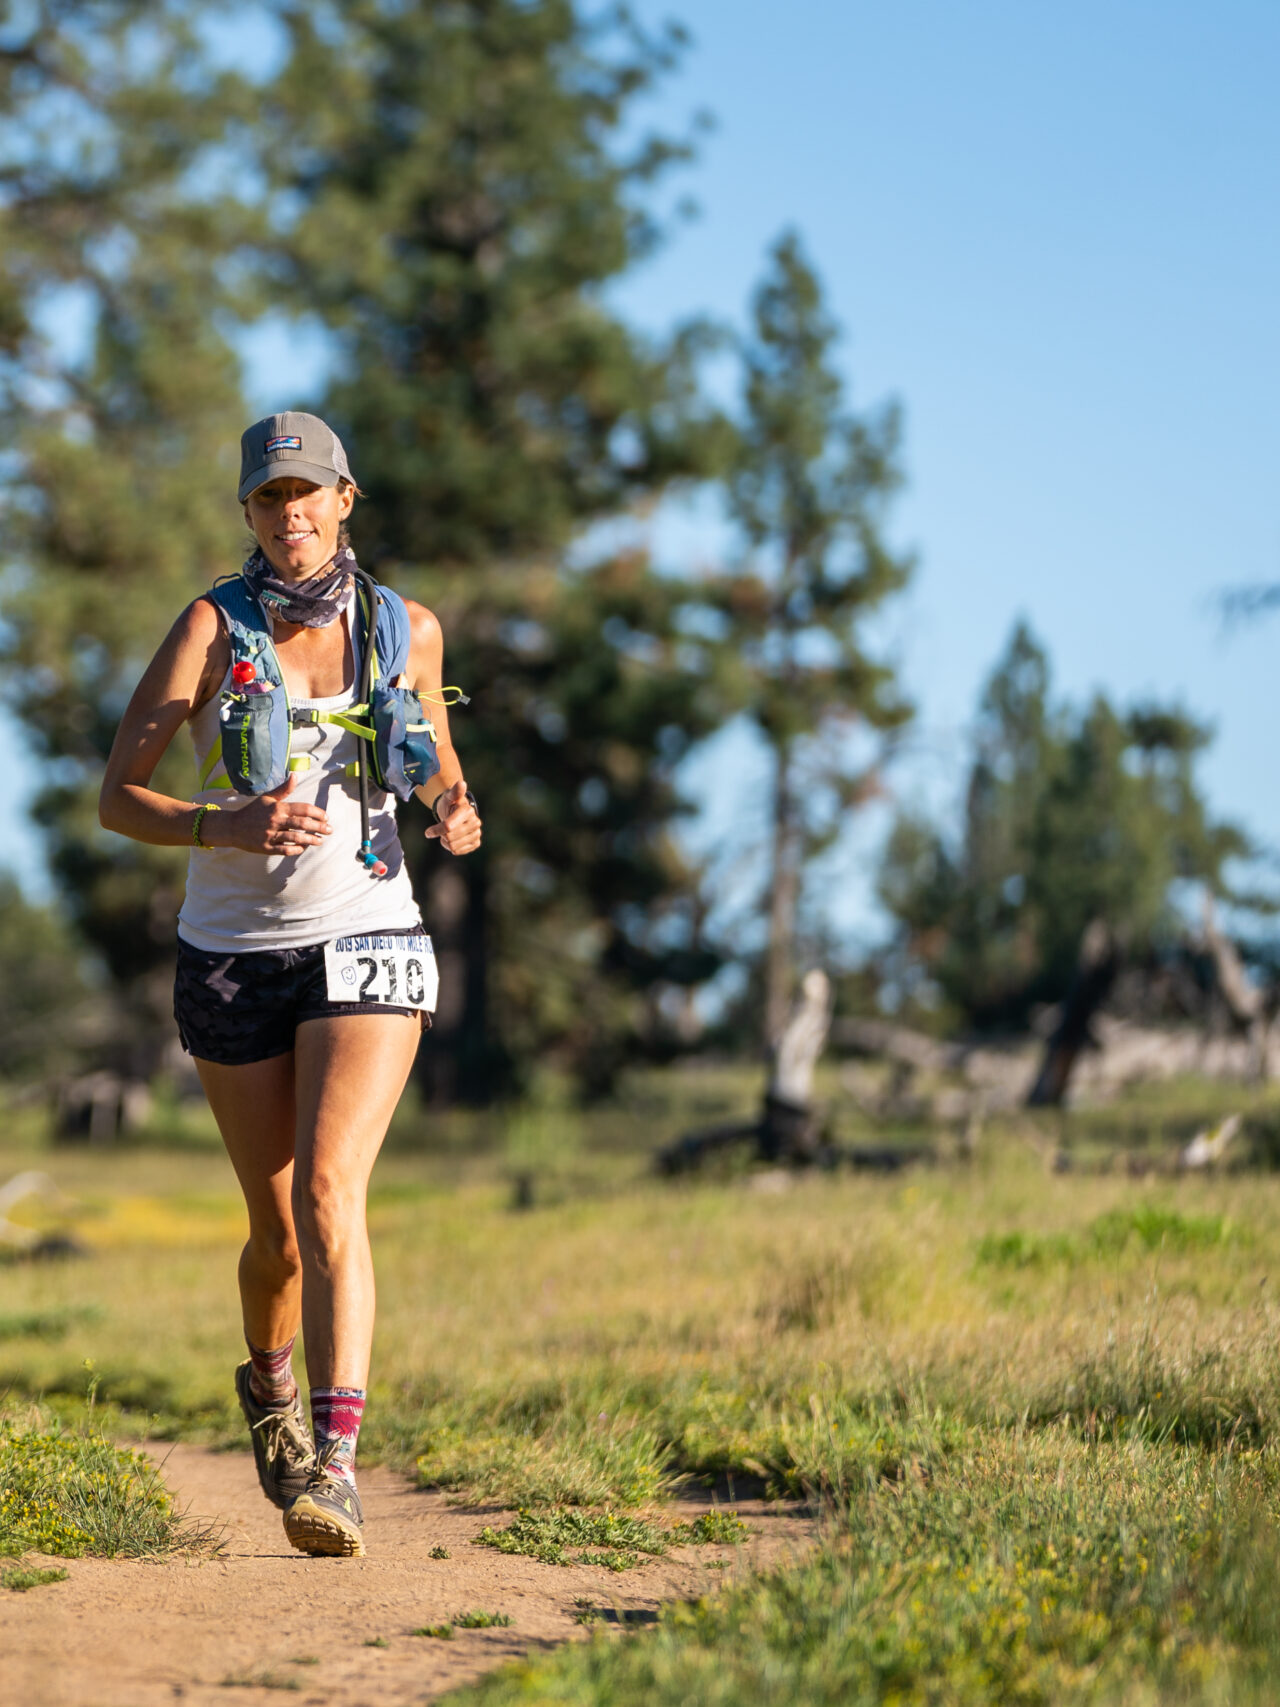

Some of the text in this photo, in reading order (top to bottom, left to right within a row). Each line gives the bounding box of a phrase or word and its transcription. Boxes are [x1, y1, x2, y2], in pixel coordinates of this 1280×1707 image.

[240, 727, 250, 777] NATHAN
[335, 936, 353, 953] 2019
[354, 936, 370, 952] SAN
[372, 936, 393, 950] DIEGO
[406, 936, 423, 953] MILE
[424, 937, 433, 954] RU
[356, 957, 425, 1004] 210
